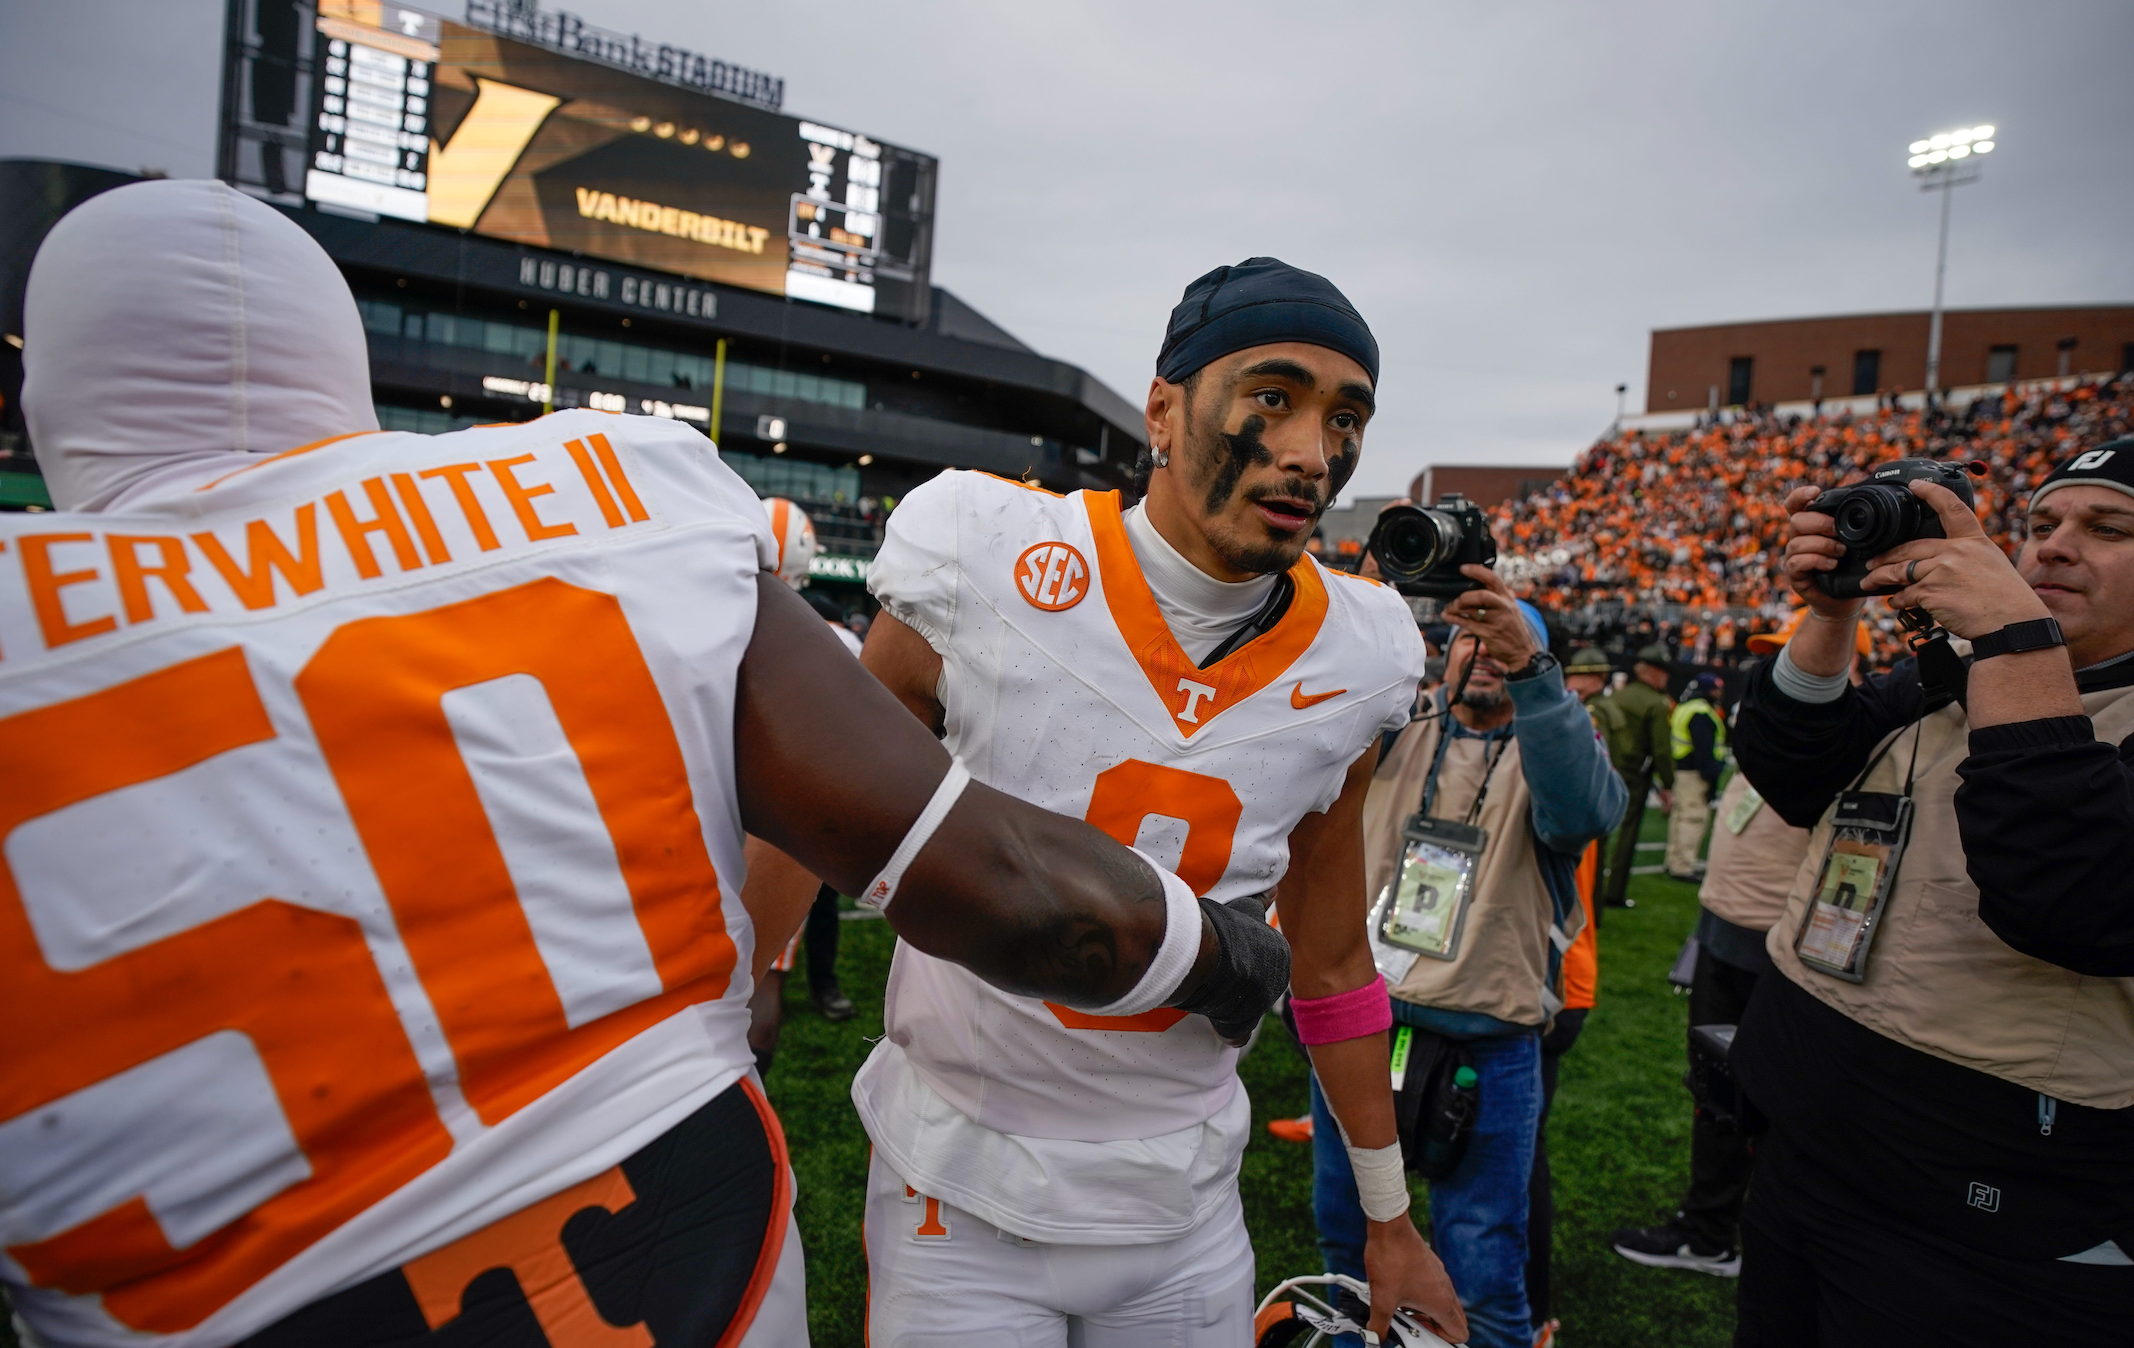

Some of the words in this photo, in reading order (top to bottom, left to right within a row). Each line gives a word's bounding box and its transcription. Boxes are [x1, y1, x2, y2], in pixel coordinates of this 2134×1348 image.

[657, 42, 785, 109] STADIUM
[576, 187, 770, 255] VANDERBILT
[520, 257, 611, 300] HUBER
[621, 276, 719, 320] CENTER
[1874, 469, 1901, 479] Canon
[0, 454, 579, 661] ERWHITE
[1020, 545, 1084, 606] SEC
[1176, 677, 1217, 724] T
[0, 577, 739, 1336] 50
[1966, 1181, 2001, 1213] FJ
